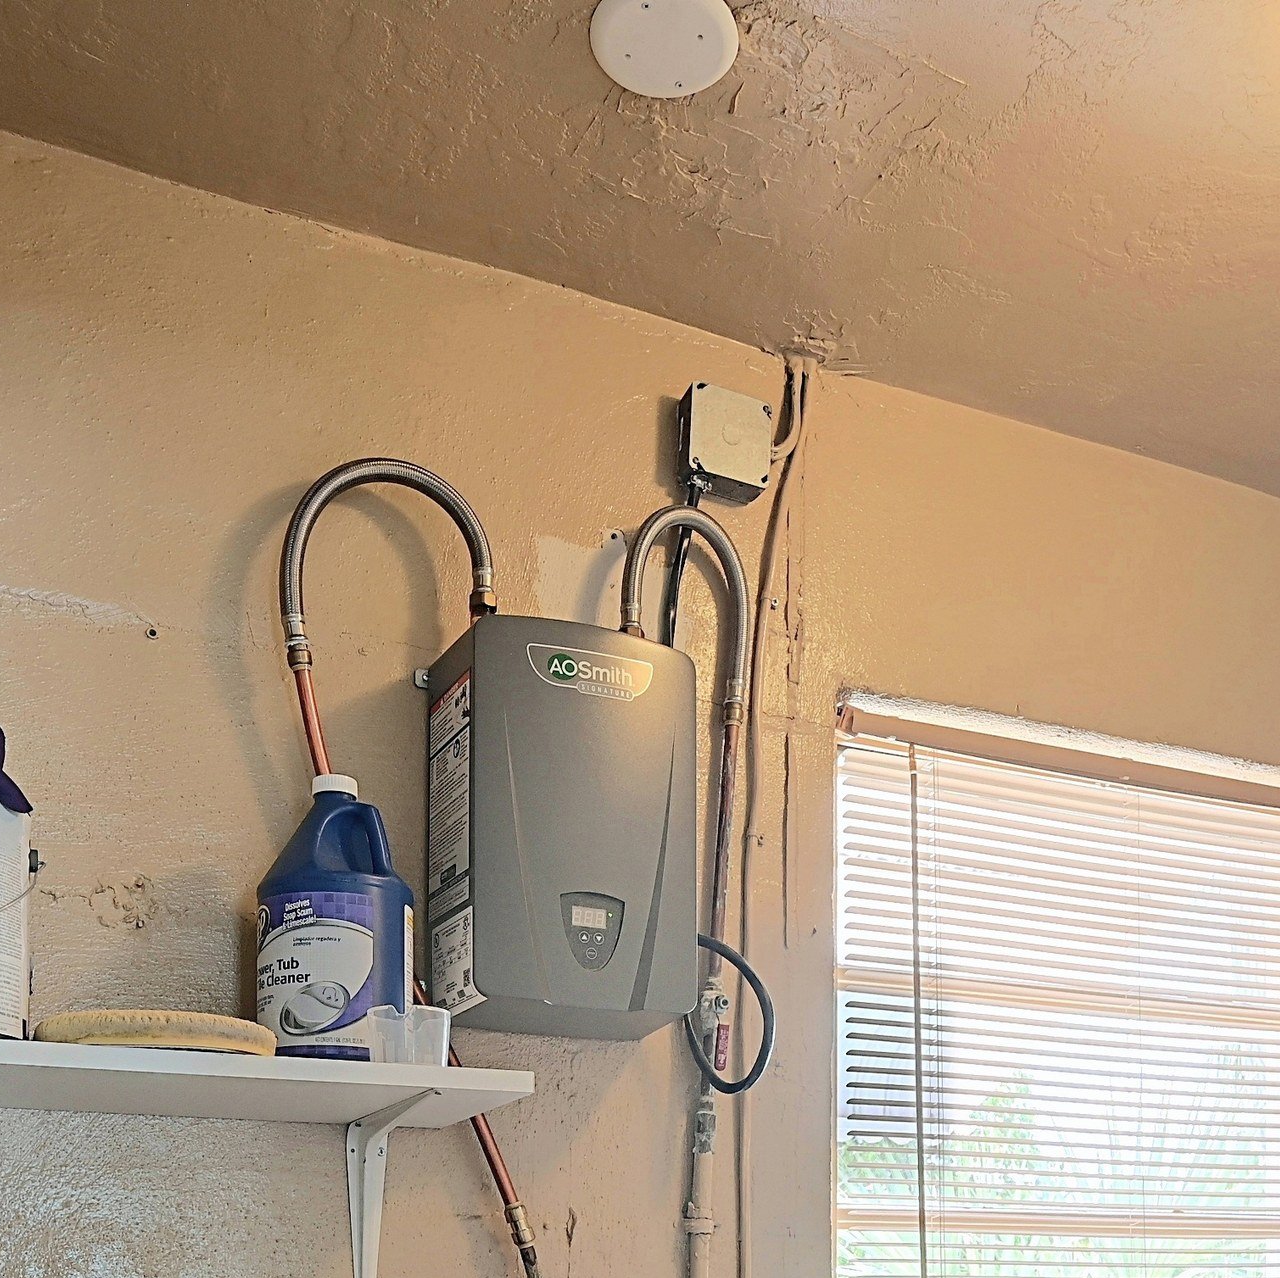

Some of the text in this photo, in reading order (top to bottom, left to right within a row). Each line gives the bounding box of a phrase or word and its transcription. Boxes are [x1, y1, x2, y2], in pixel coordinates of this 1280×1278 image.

[581, 684, 630, 698] SIGNATURE
[284, 907, 313, 921] Soap Scum
[288, 917, 316, 928] Limescale!
[277, 957, 299, 971] Tub
[267, 973, 310, 987] Cleaner
